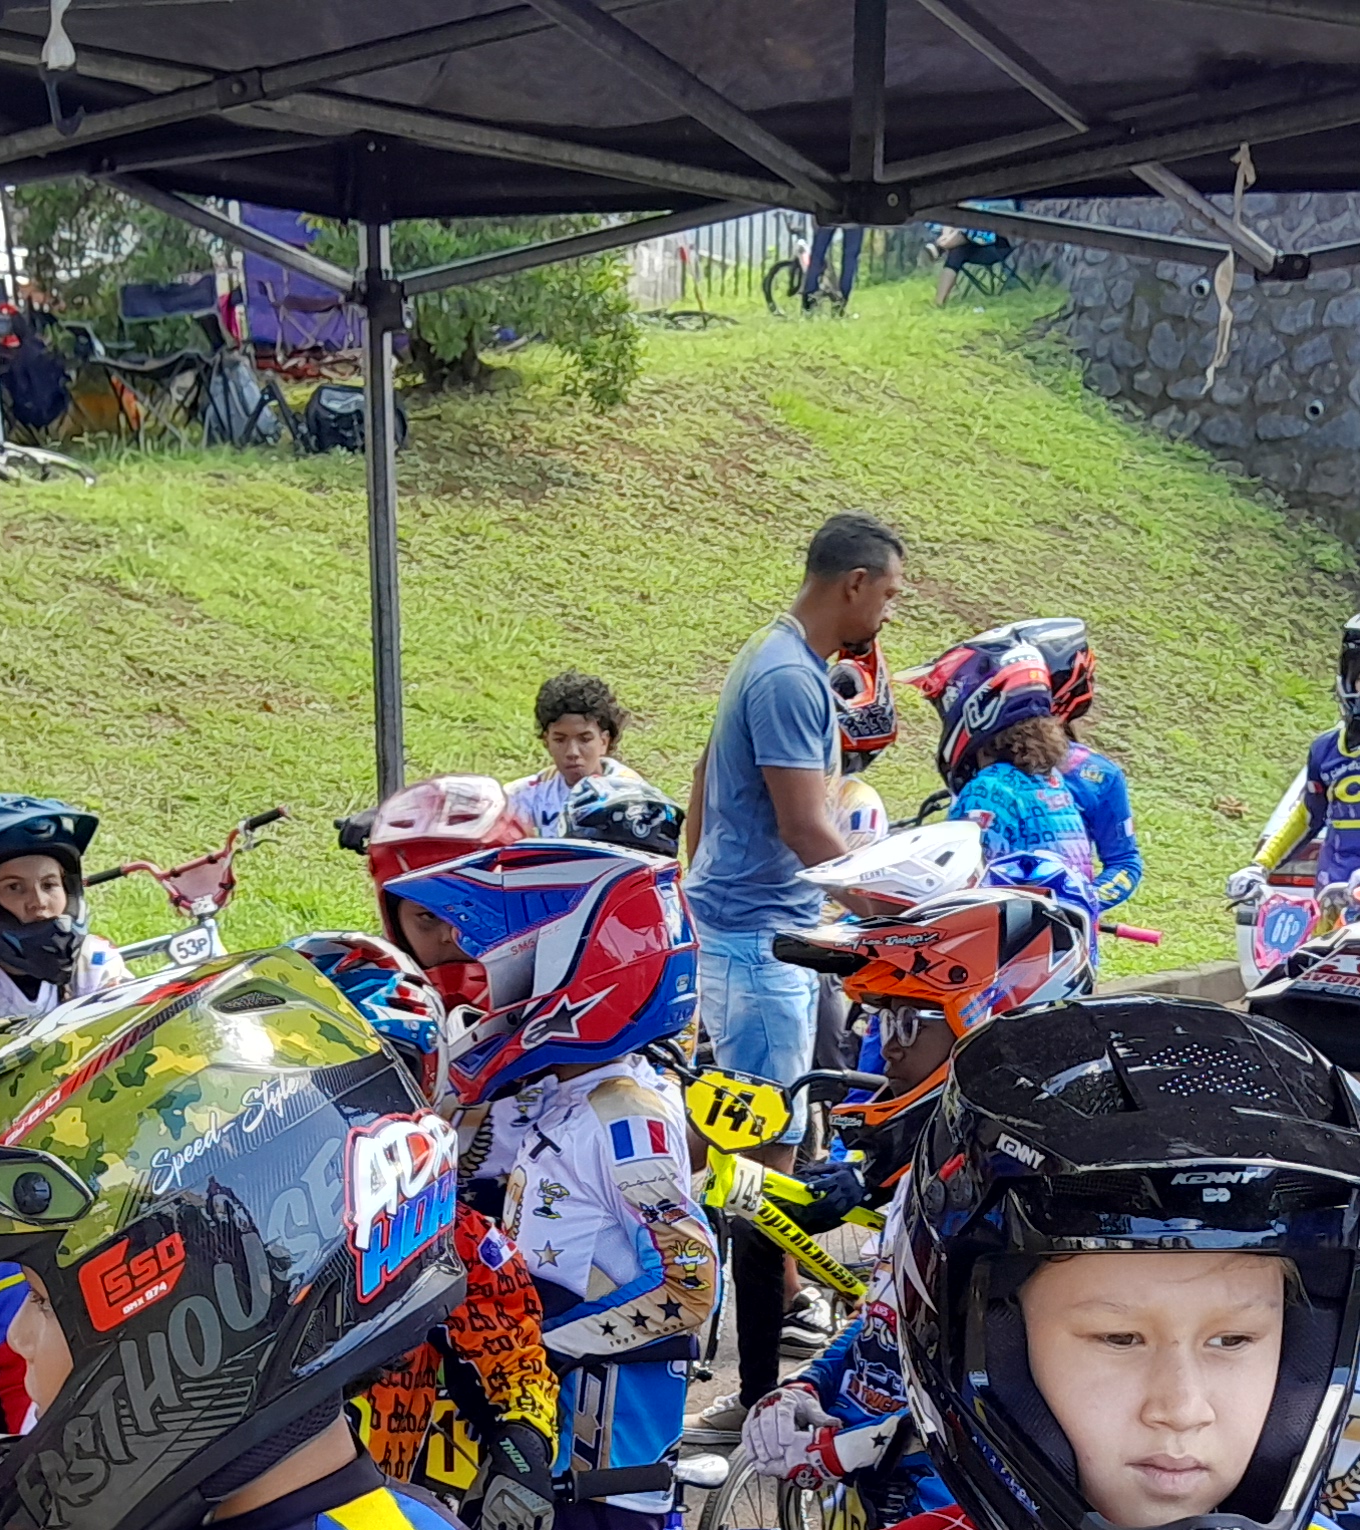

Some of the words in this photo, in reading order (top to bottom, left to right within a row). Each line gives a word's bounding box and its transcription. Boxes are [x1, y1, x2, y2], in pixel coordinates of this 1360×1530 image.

[996, 1132, 1047, 1171] KENNY
[1170, 1171, 1258, 1185] KENNY
[498, 1436, 530, 1476] THOR
